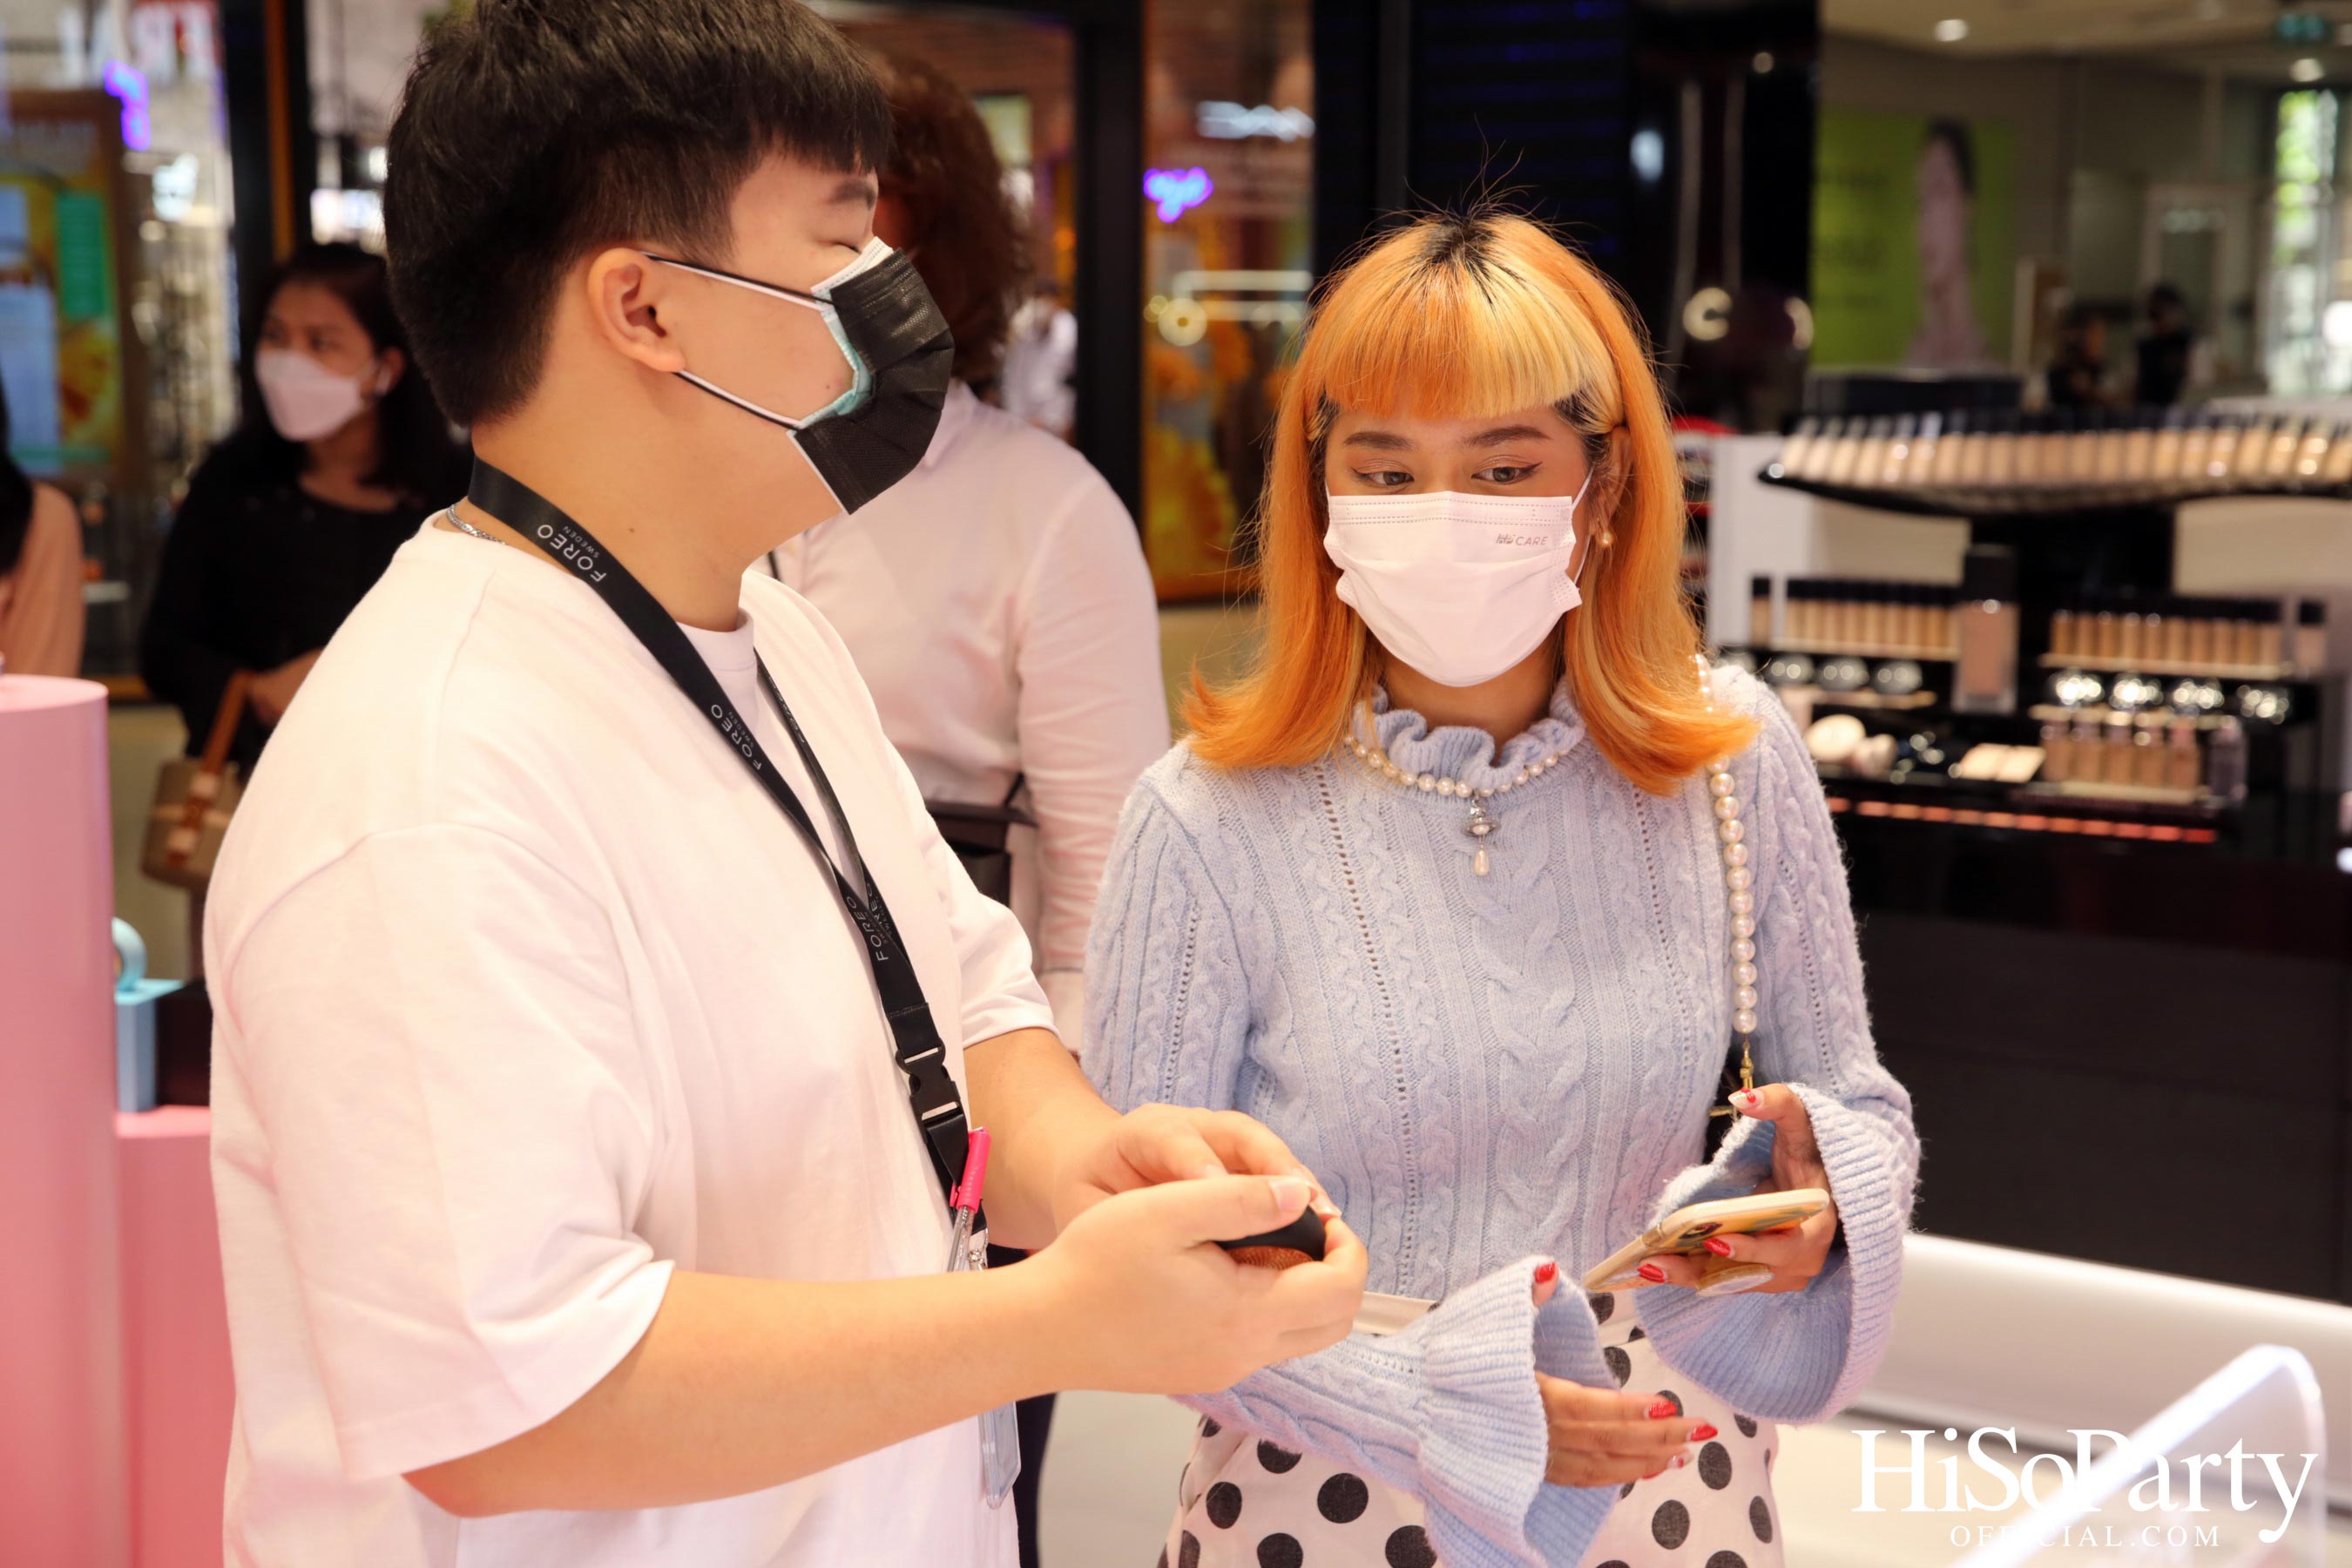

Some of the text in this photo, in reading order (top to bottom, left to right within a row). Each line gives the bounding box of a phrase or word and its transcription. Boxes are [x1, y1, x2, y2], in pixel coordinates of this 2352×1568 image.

[537, 524, 606, 582] FOREO
[563, 526, 600, 558] SWEDEN
[1516, 536, 1549, 545] CARE
[711, 704, 762, 770] FOREO
[846, 896, 889, 961] FOREO
